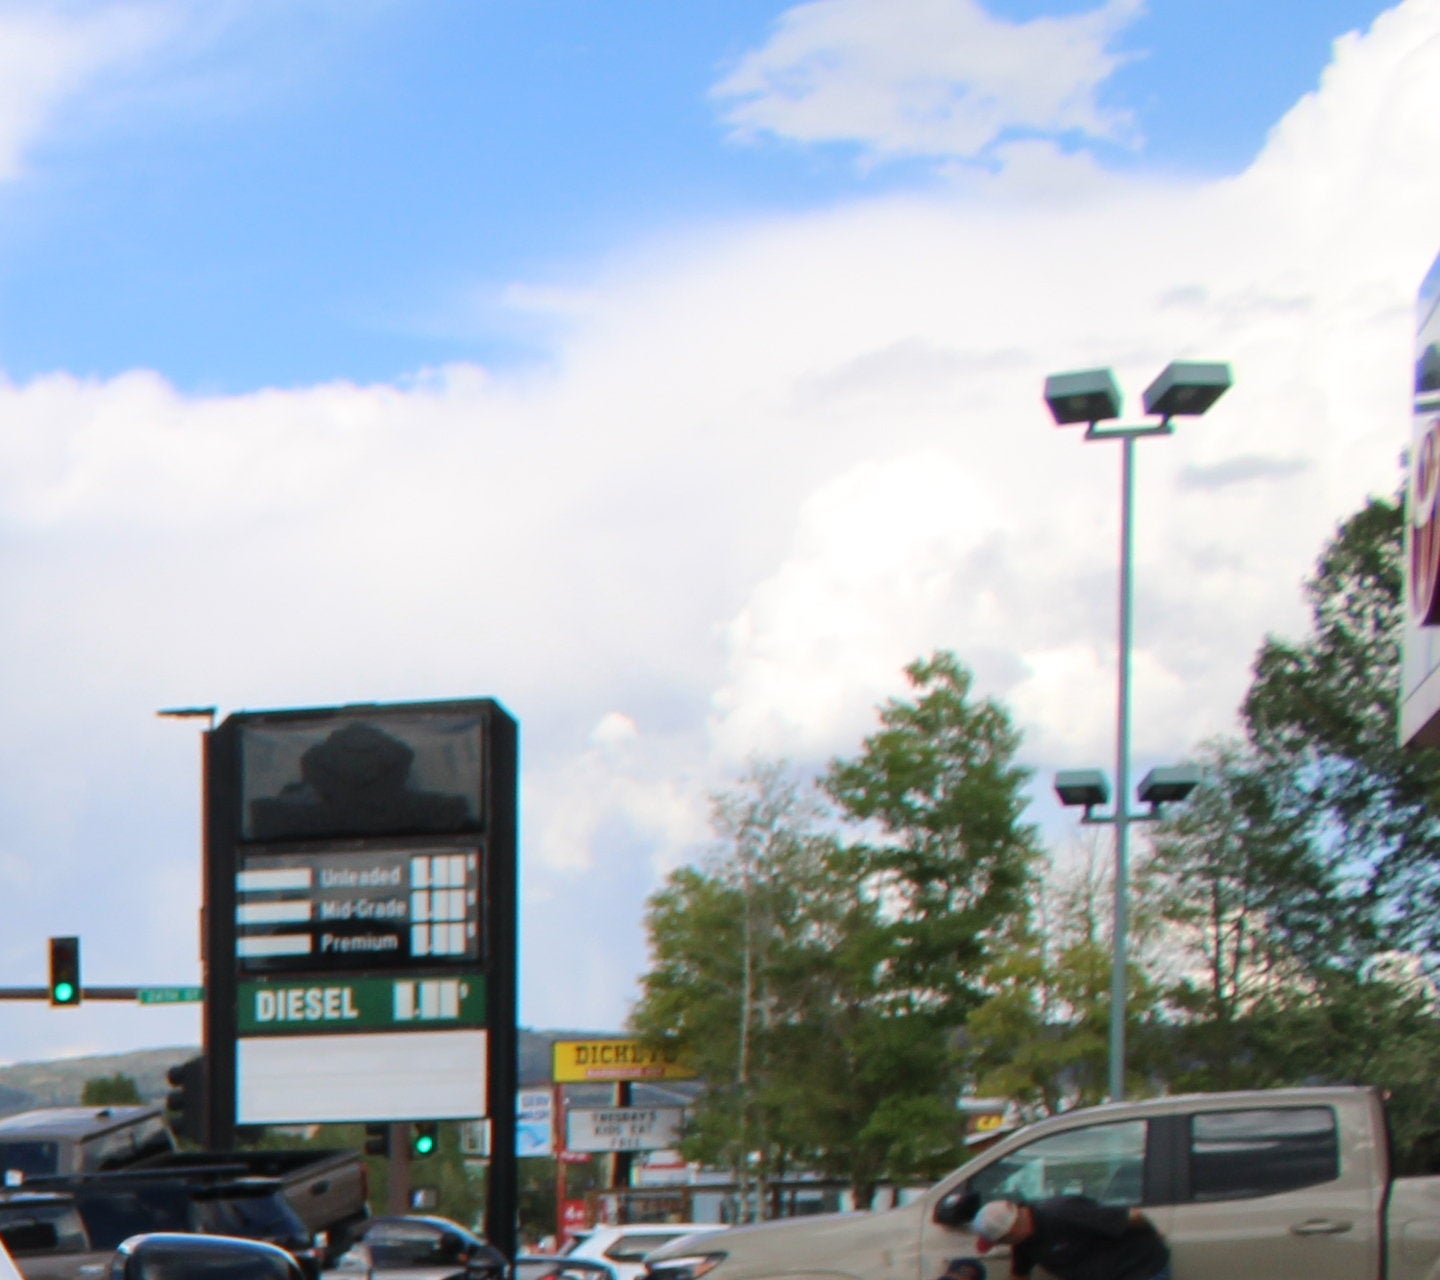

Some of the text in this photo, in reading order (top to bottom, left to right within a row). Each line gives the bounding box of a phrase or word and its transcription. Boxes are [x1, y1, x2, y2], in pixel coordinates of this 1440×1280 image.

[319, 864, 402, 888] Unleaded
[319, 897, 408, 921] Mid-Grade
[319, 932, 399, 953] Premium
[254, 986, 360, 1022] DIESEL
